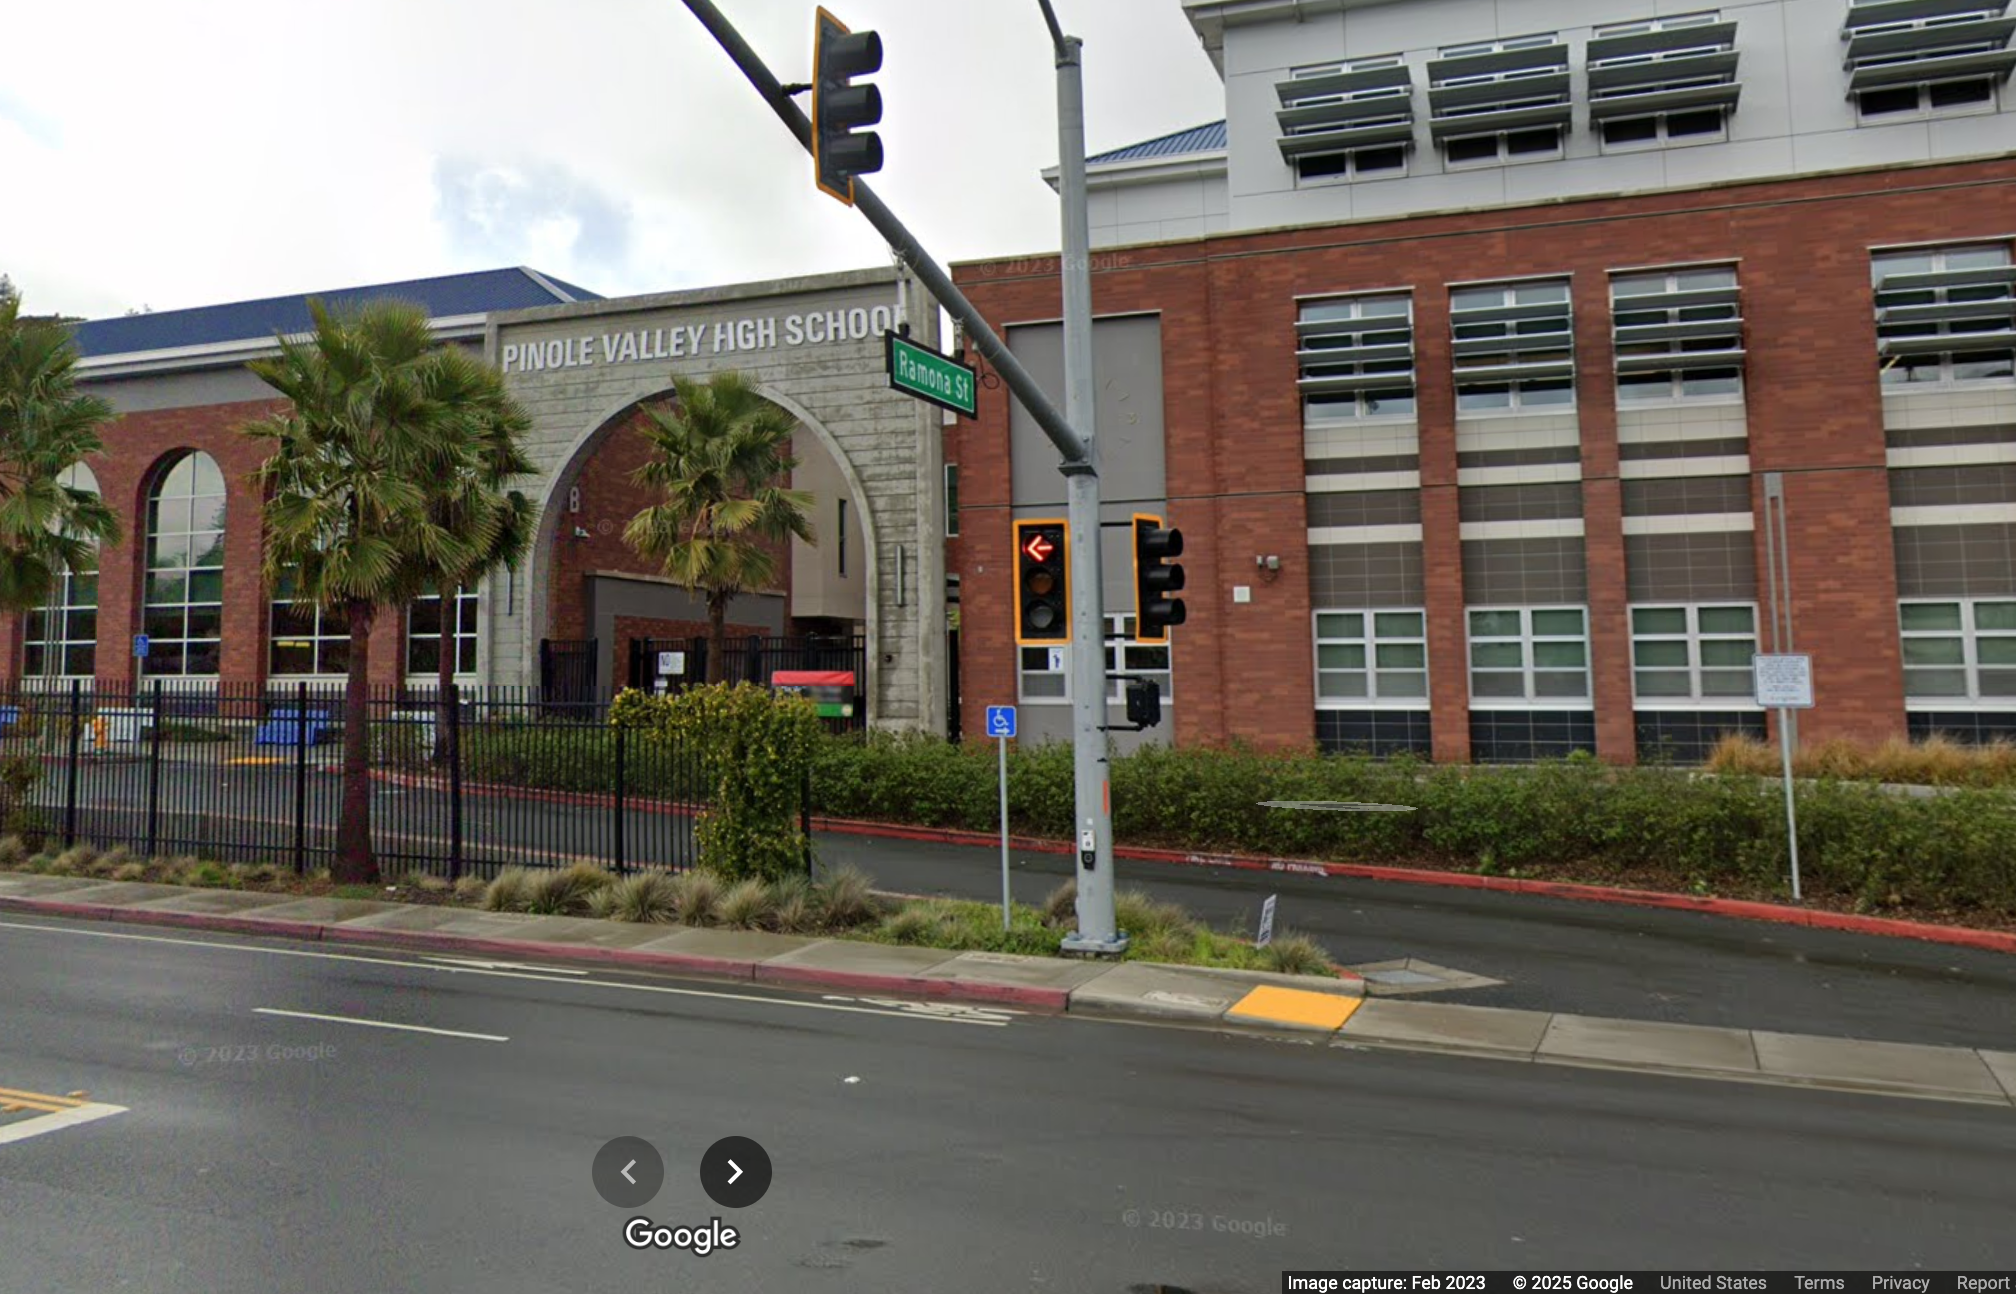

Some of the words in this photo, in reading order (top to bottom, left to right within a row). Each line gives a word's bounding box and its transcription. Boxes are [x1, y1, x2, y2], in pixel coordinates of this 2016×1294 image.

[503, 336, 595, 373] PINOLE
[602, 324, 707, 363] VALLEY
[899, 349, 951, 396] Ramona
[955, 374, 969, 403] St
